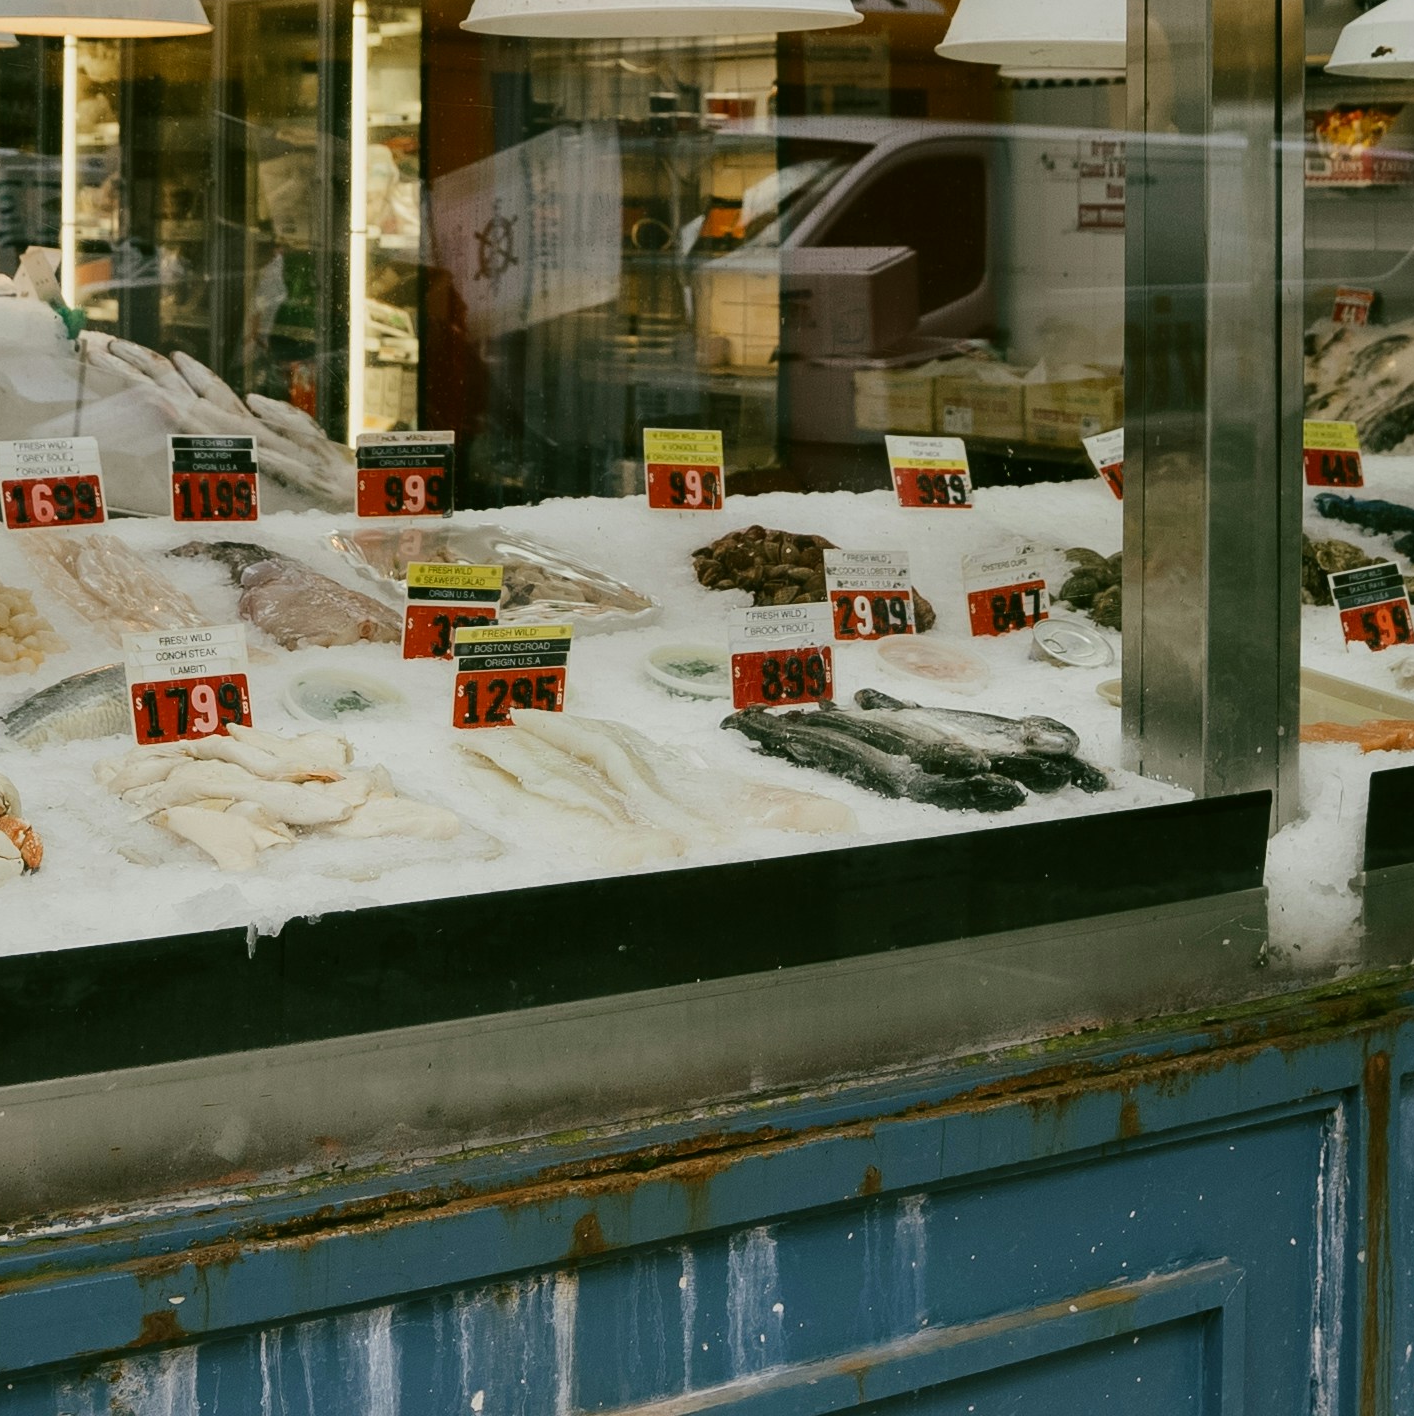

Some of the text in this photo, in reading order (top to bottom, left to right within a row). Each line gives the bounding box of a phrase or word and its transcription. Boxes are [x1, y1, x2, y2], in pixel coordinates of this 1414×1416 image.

[19, 441, 46, 450] FRESH
[191, 439, 216, 447] FRESH
[427, 566, 474, 576] FRESH WILD
[423, 576, 486, 586] SEAWEED SALAD
[429, 590, 455, 598] ORIGIN
[751, 609, 802, 620] FRESH WILD
[482, 627, 537, 638] FRESH WILD
[750, 624, 808, 635] BROOK TROUT
[190, 632, 212, 642] WILD
[473, 641, 551, 654] BOSTON SCROAD
[155, 647, 218, 662] CONCH STEAK
[484, 657, 517, 667] ORIGIN
[170, 664, 207, 676] (LAMBIT)
